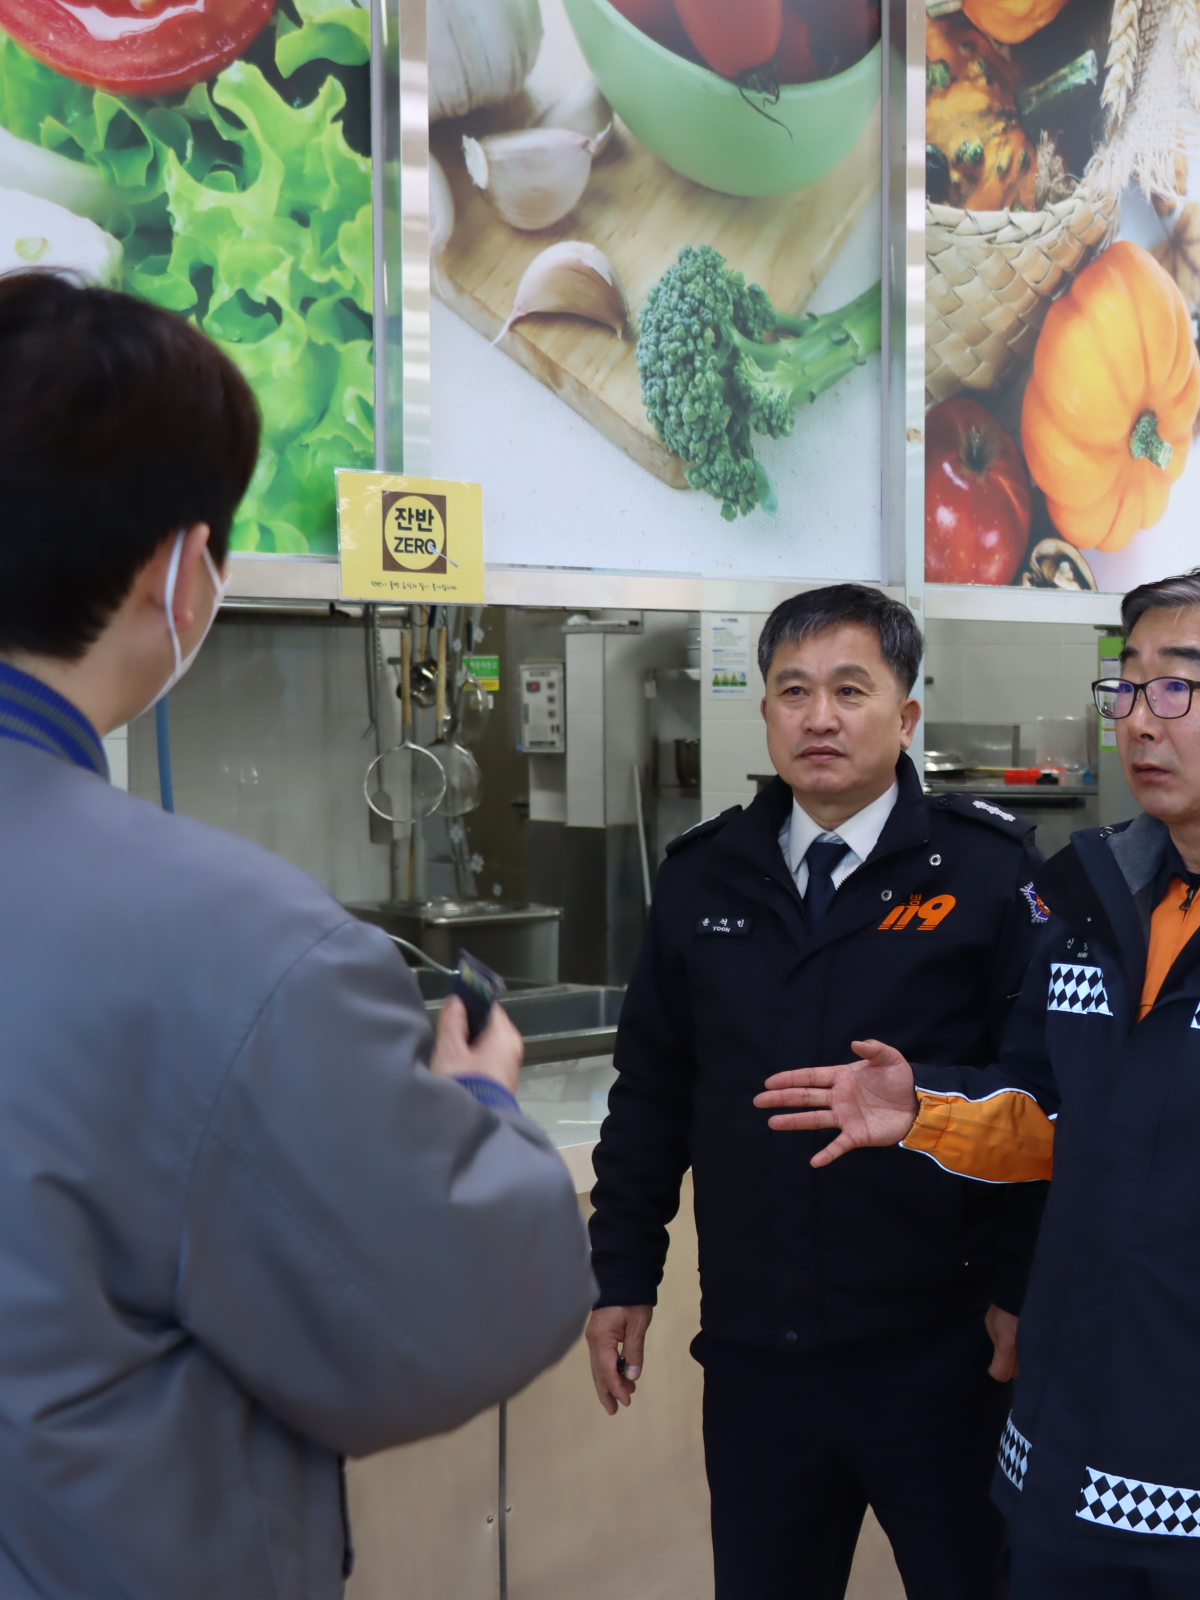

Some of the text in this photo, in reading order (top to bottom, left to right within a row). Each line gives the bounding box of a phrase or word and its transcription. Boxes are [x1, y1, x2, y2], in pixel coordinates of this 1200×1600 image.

[394, 507, 435, 532] 잔반
[393, 536, 437, 555] ZERO
[877, 894, 957, 930] 119
[712, 925, 731, 933] YOON
